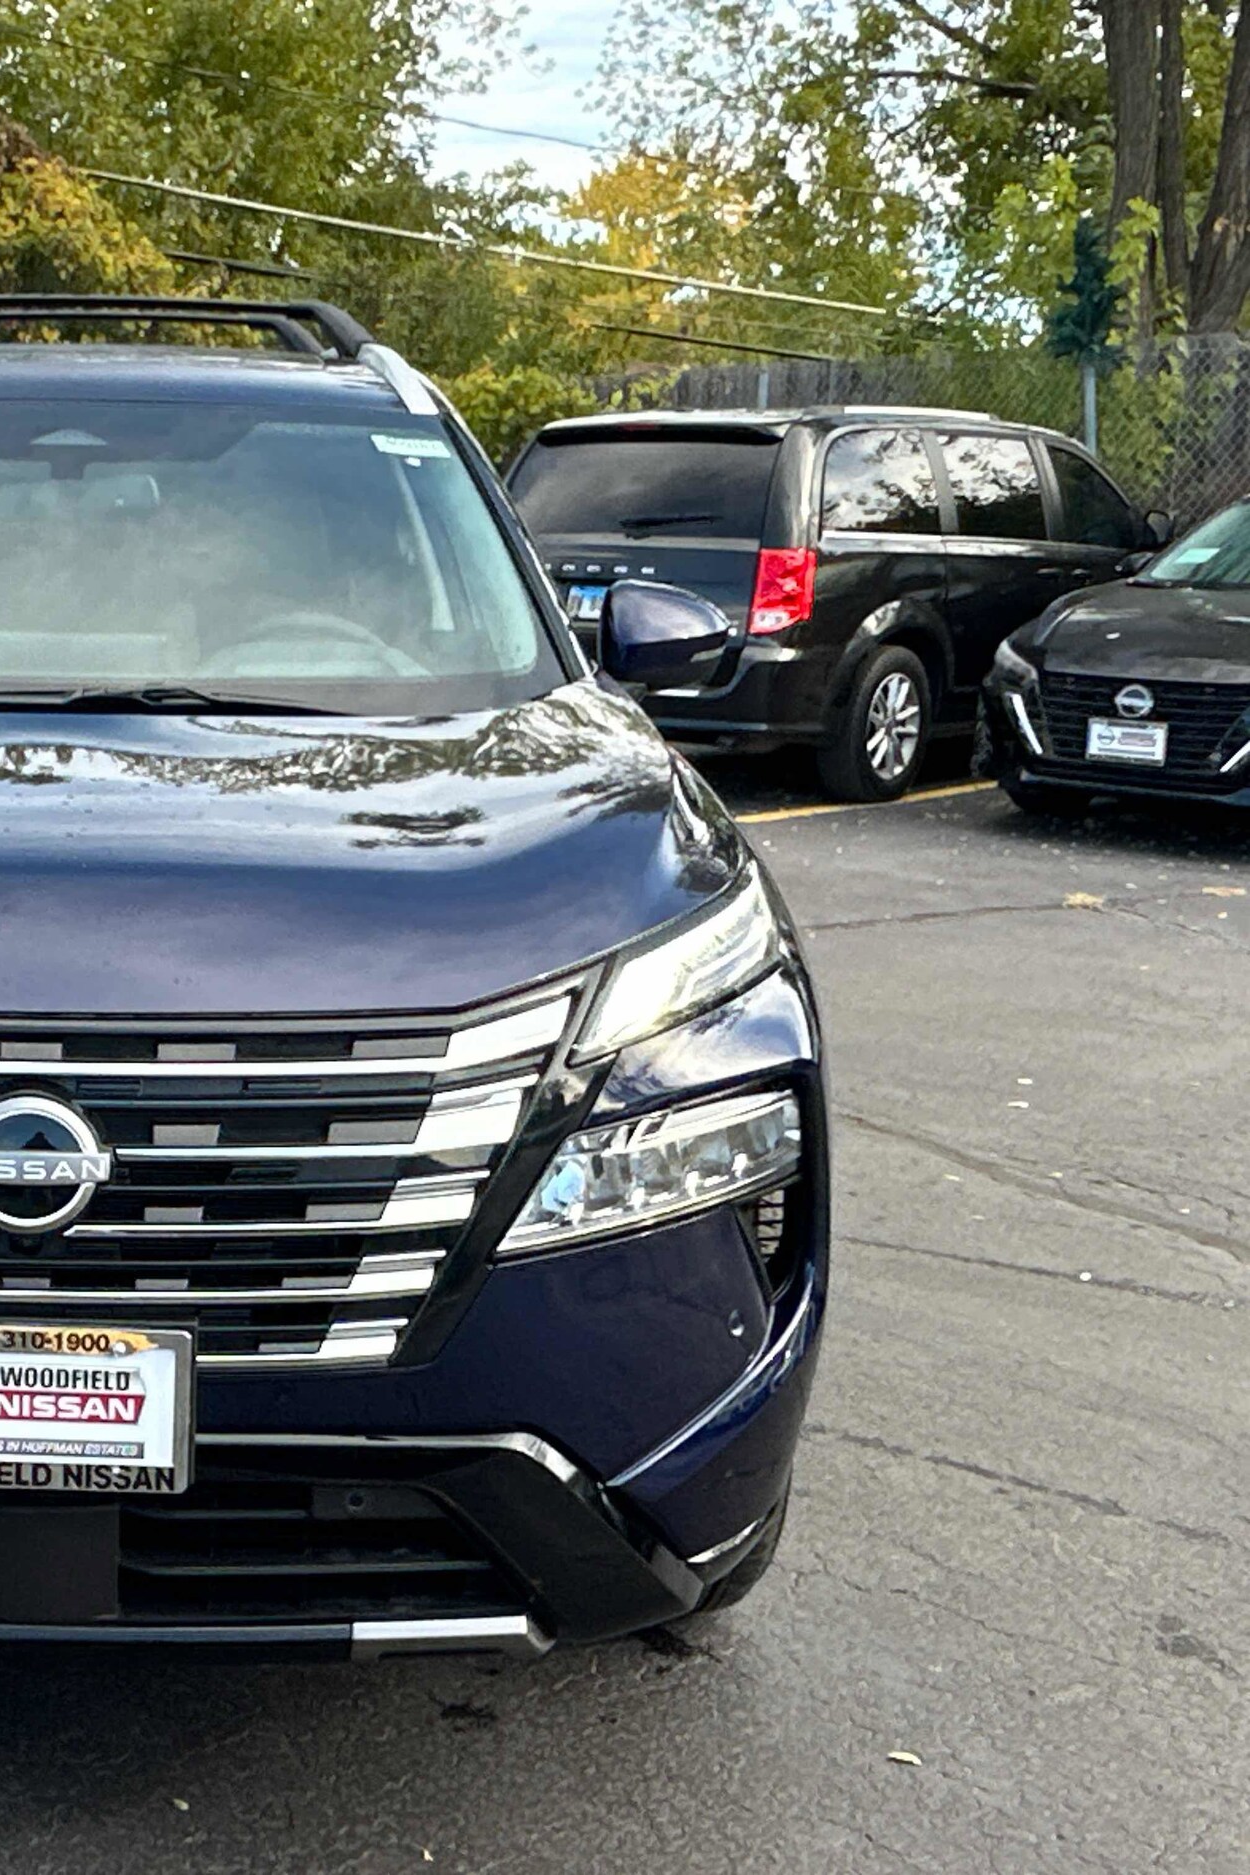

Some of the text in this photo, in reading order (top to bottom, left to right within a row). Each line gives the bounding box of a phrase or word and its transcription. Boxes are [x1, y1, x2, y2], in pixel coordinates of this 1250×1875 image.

[2, 1330, 111, 1351] 310-1900
[0, 1366, 130, 1391] WOODFIELD
[6, 1441, 20, 1453] IN
[63, 1464, 175, 1491] NISSAN
